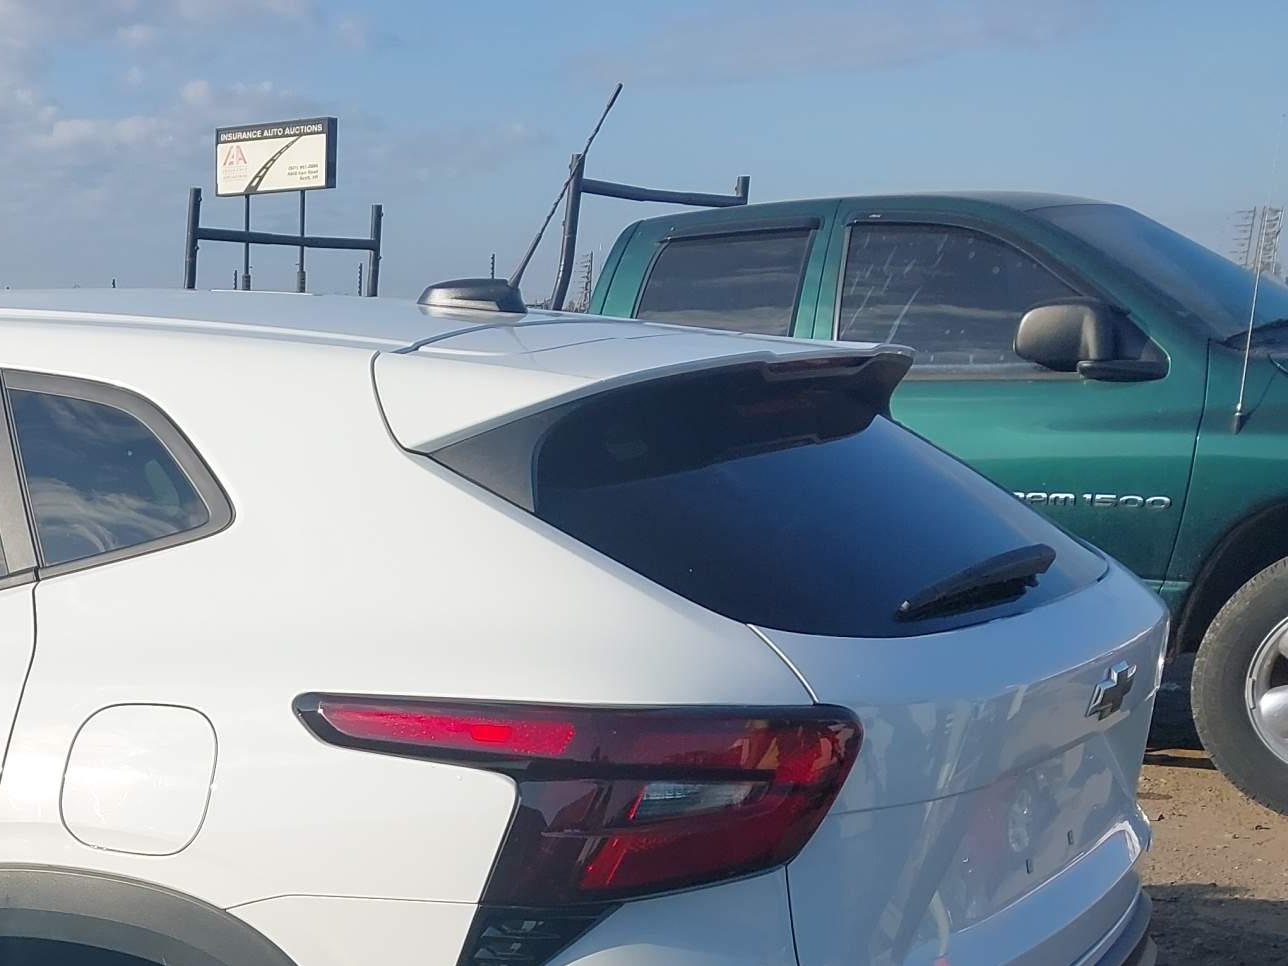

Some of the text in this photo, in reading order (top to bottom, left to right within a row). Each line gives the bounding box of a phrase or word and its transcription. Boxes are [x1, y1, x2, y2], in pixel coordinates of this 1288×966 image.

[220, 123, 323, 142] INSURANCE AUTO AUCTIONS
[1083, 493, 1173, 509] 1500
